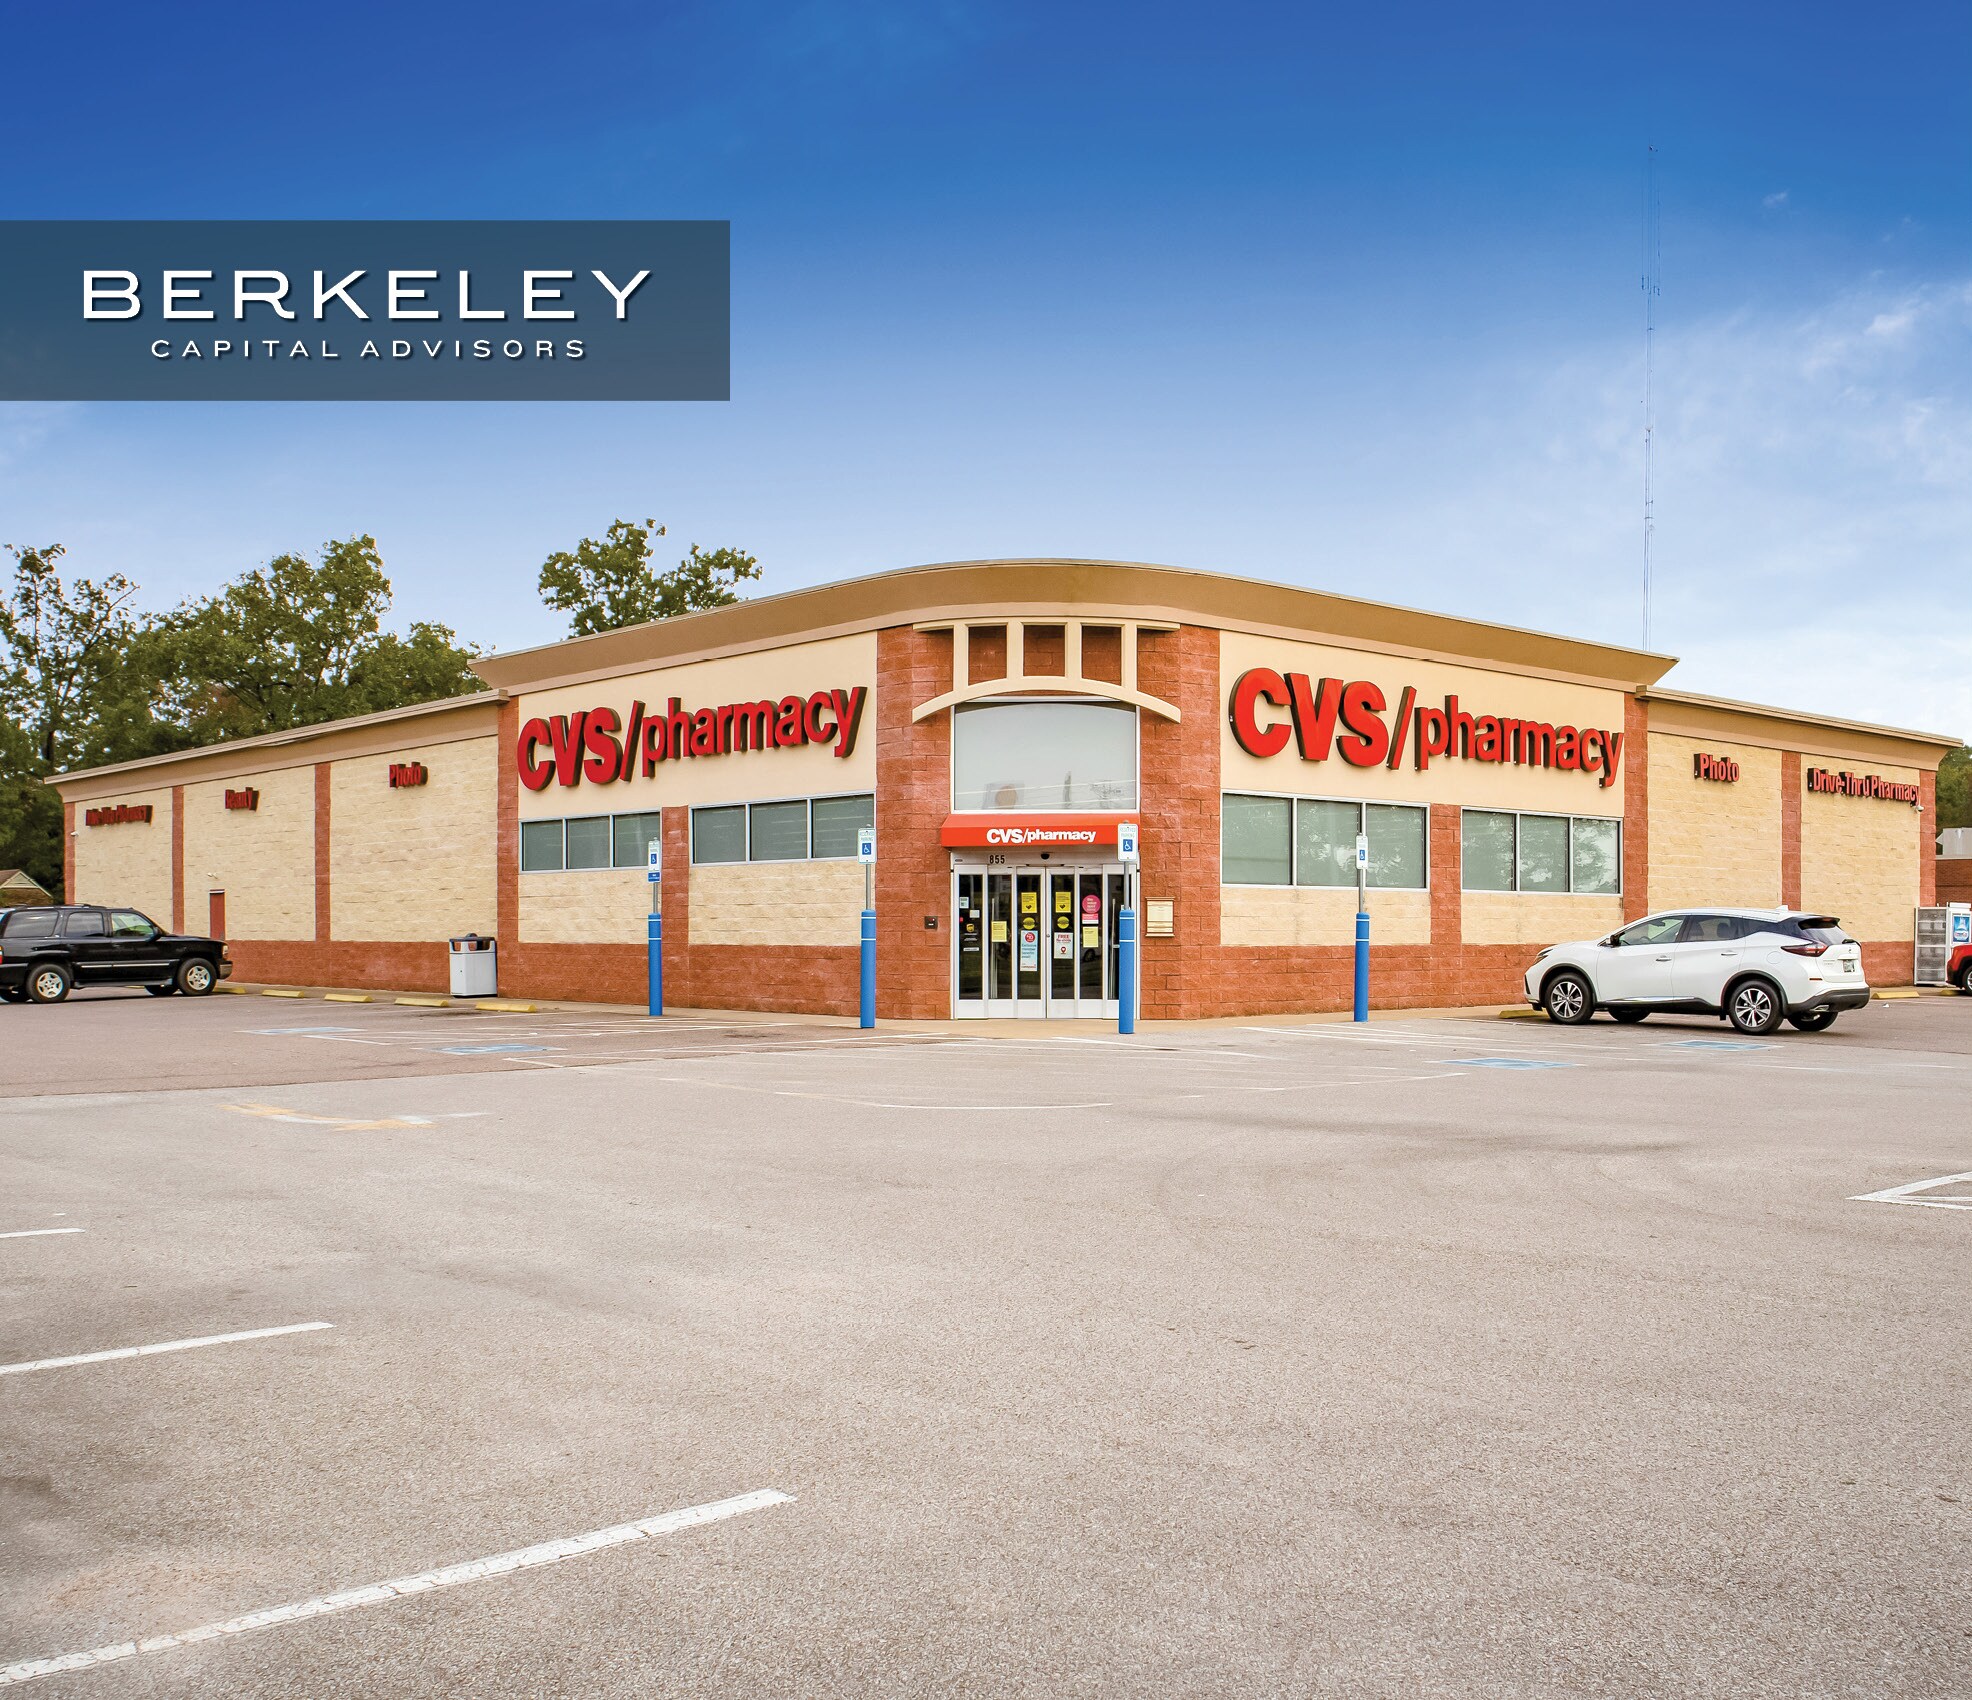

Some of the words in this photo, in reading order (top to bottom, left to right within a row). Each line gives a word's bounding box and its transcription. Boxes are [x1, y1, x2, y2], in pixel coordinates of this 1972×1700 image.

[517, 686, 868, 791] CVS/pharmacy
[1229, 667, 1624, 788] CVS/pharmacy
[389, 762, 428, 788] Photo
[1695, 753, 1740, 782] Photo
[1808, 768, 1870, 797] Drive-Thru
[1870, 775, 1920, 805] Pharmacy
[986, 828, 1096, 843] CVS/pharmacy
[989, 854, 1005, 865] 855
